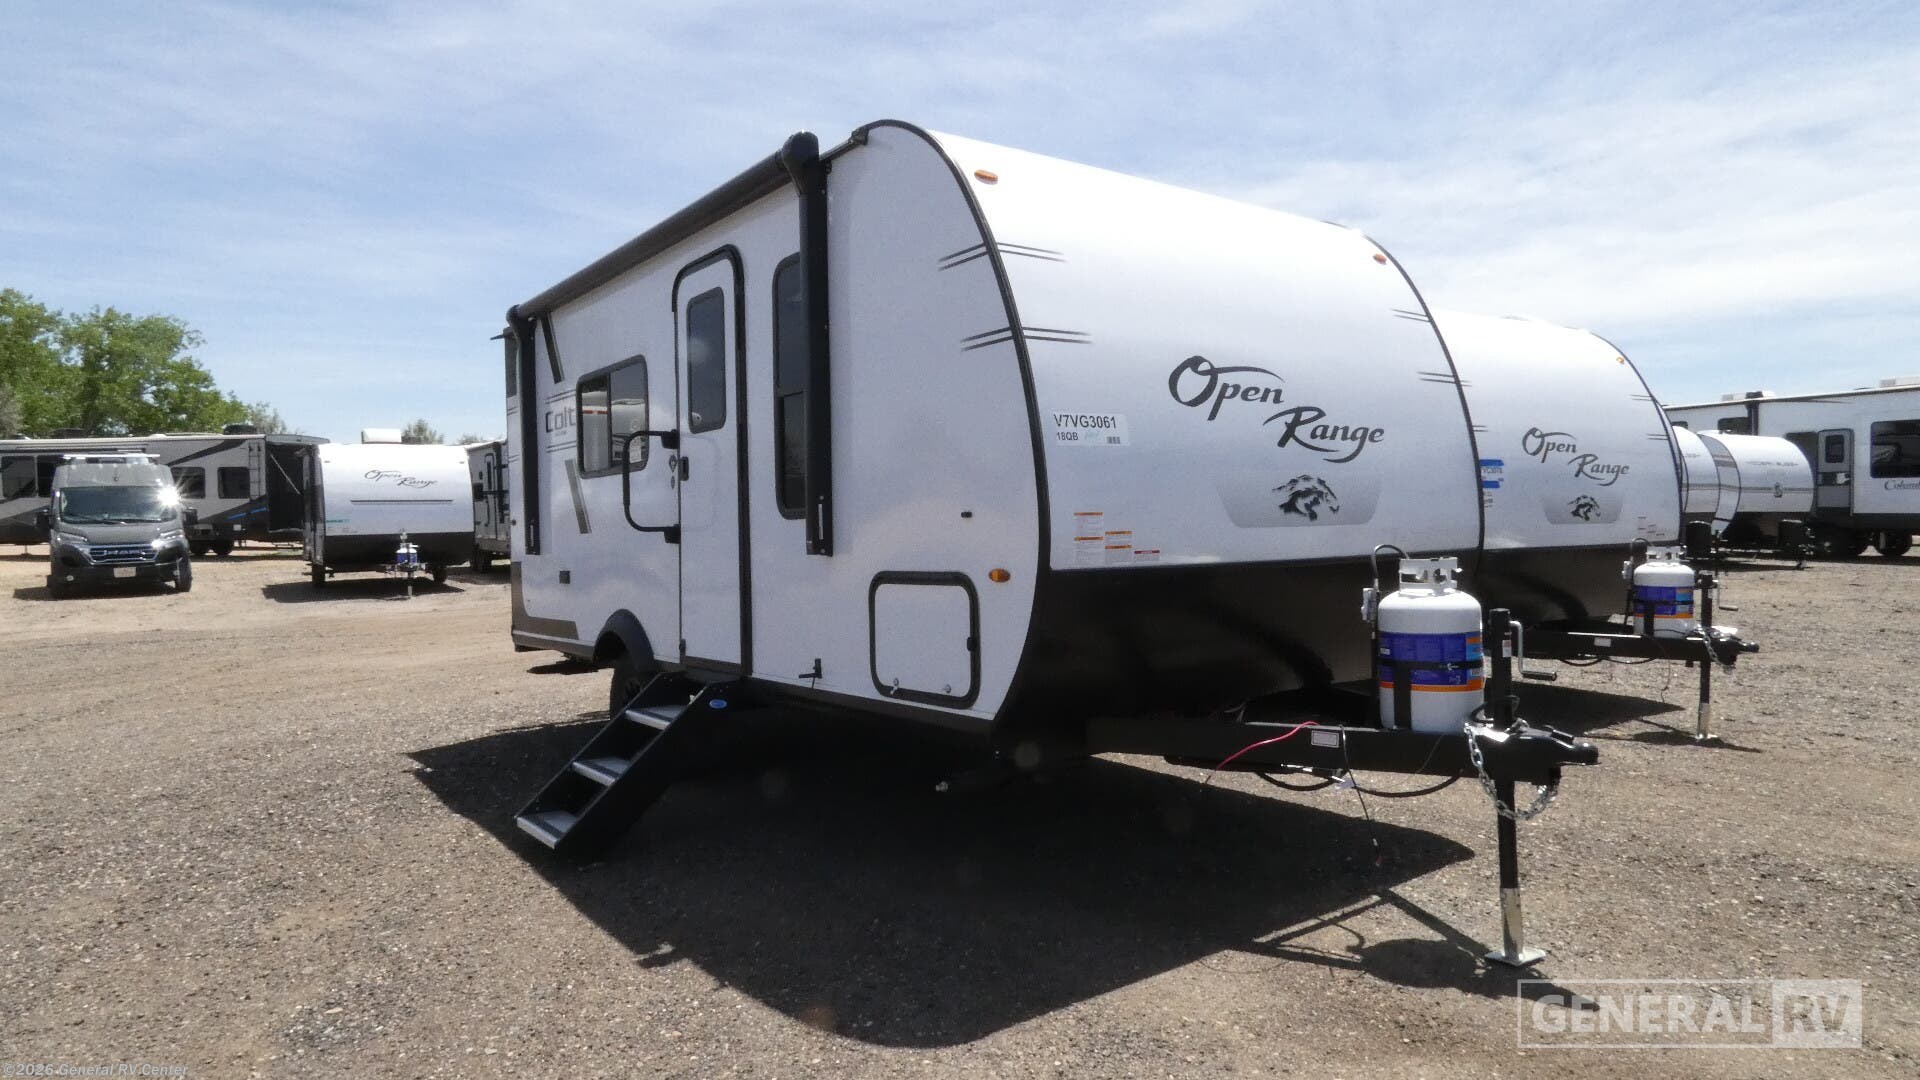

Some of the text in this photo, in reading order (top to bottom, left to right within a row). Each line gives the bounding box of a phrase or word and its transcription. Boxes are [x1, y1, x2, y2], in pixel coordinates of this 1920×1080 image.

[1168, 355, 1285, 421] Open
[545, 406, 576, 433] Colt
[1053, 413, 1117, 429] V7VG3061
[1262, 406, 1385, 463] Range
[1522, 427, 1577, 464] Open
[1567, 453, 1630, 487] Range
